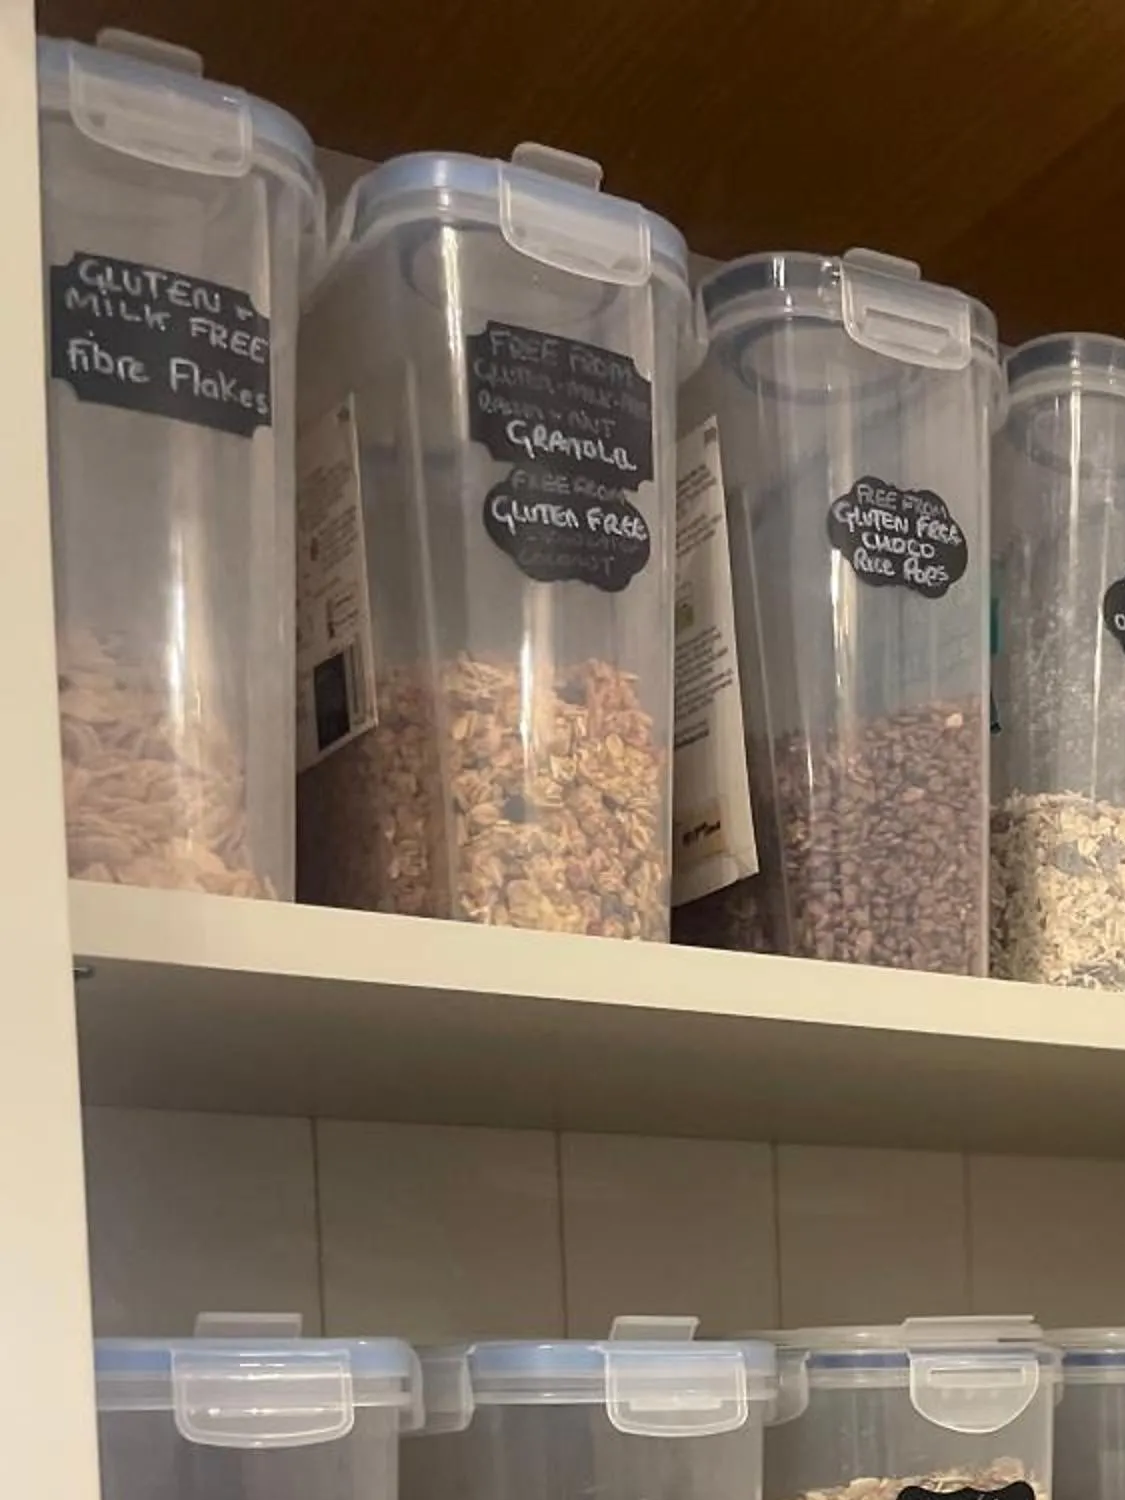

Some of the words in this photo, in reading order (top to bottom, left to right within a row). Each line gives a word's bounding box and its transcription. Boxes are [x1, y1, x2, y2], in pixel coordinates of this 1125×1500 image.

[79, 259, 222, 314] GLUTEN
[189, 316, 270, 364] FREE
[586, 507, 649, 541] FREE
[833, 500, 909, 533] GLUTEN
